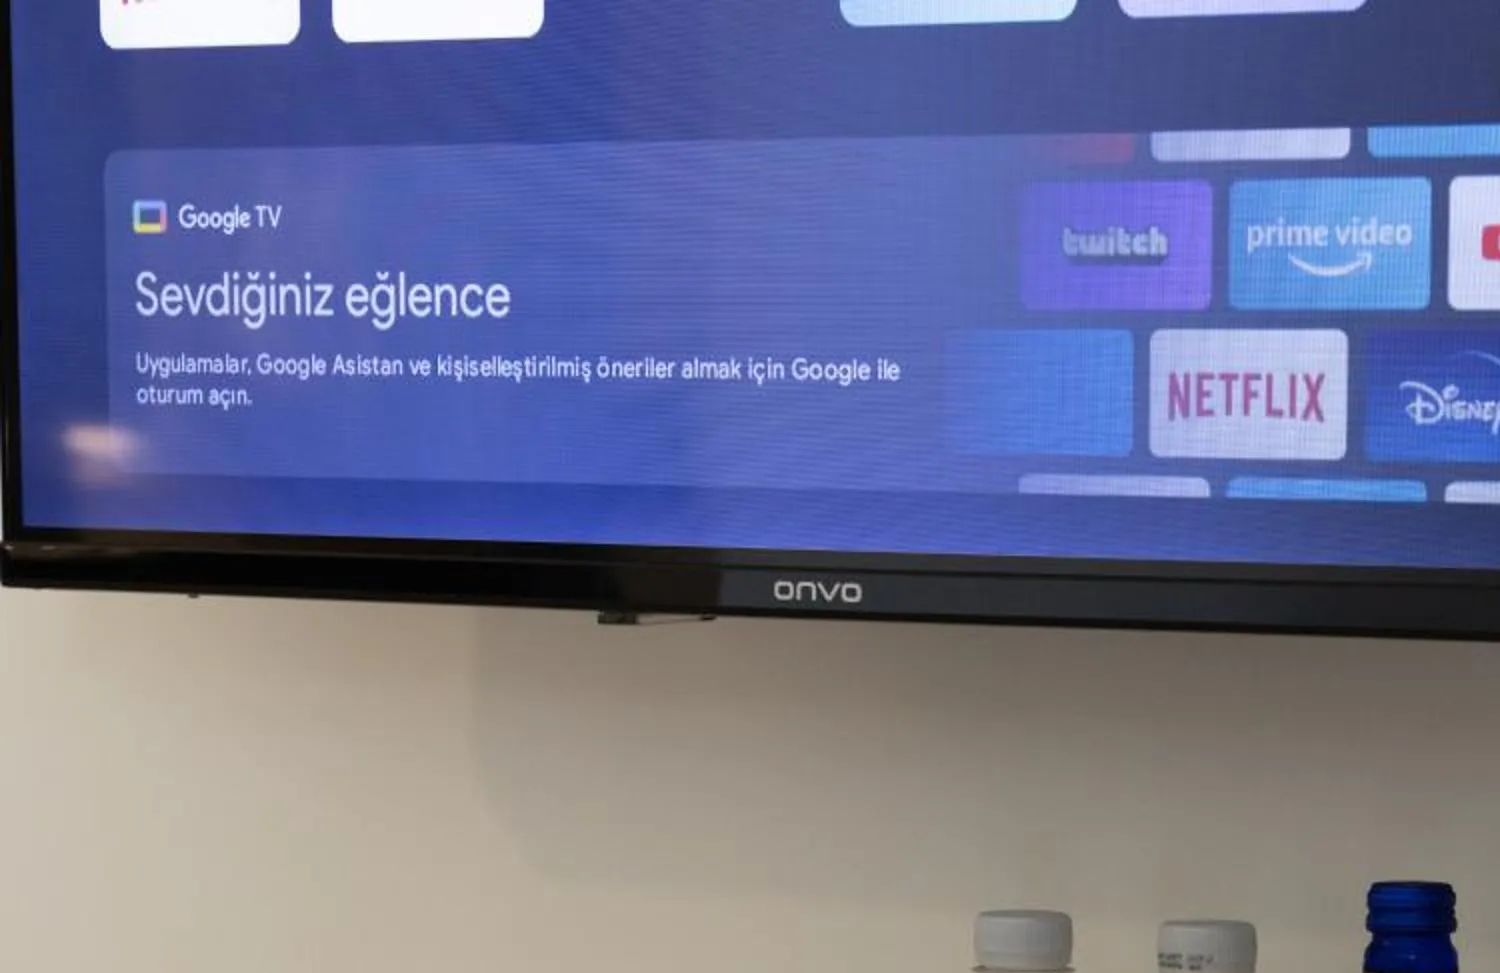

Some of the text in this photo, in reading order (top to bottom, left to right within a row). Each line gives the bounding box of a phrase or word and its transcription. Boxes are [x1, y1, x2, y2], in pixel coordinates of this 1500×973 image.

[178, 204, 282, 235] Google TV
[1246, 219, 1413, 253] prime video
[1062, 226, 1169, 264] twitch
[136, 270, 511, 331] Sevdiğiniz eğlence
[135, 352, 901, 386] Uygulamalar, Google Asistan ve kişiselleştirilmiş öneriler almak için Google ile
[136, 385, 253, 410] oturum açın.
[1167, 371, 1326, 424] NETFLIX
